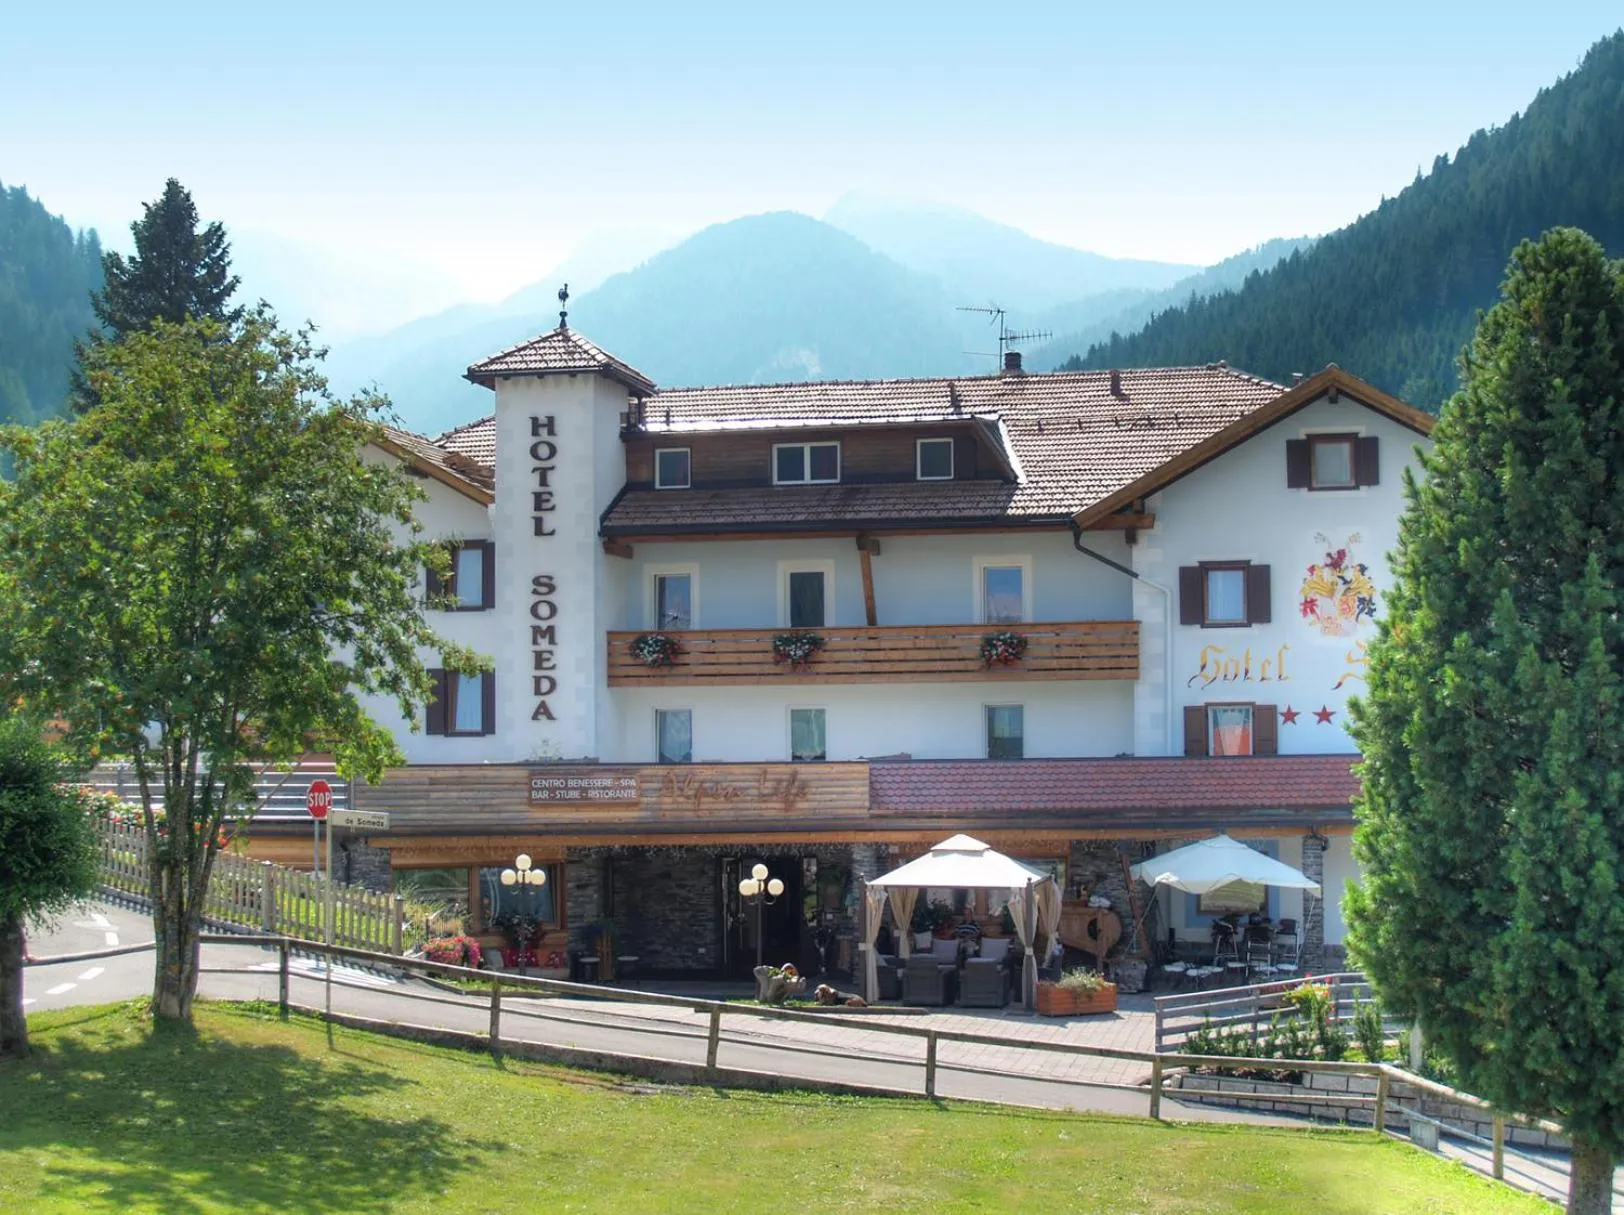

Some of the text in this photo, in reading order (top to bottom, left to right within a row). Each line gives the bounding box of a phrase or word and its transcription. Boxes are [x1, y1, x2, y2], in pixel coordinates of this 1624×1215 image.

[529, 416, 558, 721] HOTEL SOMEDA
[1187, 643, 1291, 690] Hotel
[531, 779, 566, 788] CENTRO
[568, 778, 613, 787] BENESSERE
[620, 778, 637, 787] SPA
[308, 792, 331, 807] STOP
[531, 790, 549, 799] BAR
[555, 790, 581, 799] STUBE
[587, 789, 637, 798] RISTORANTE
